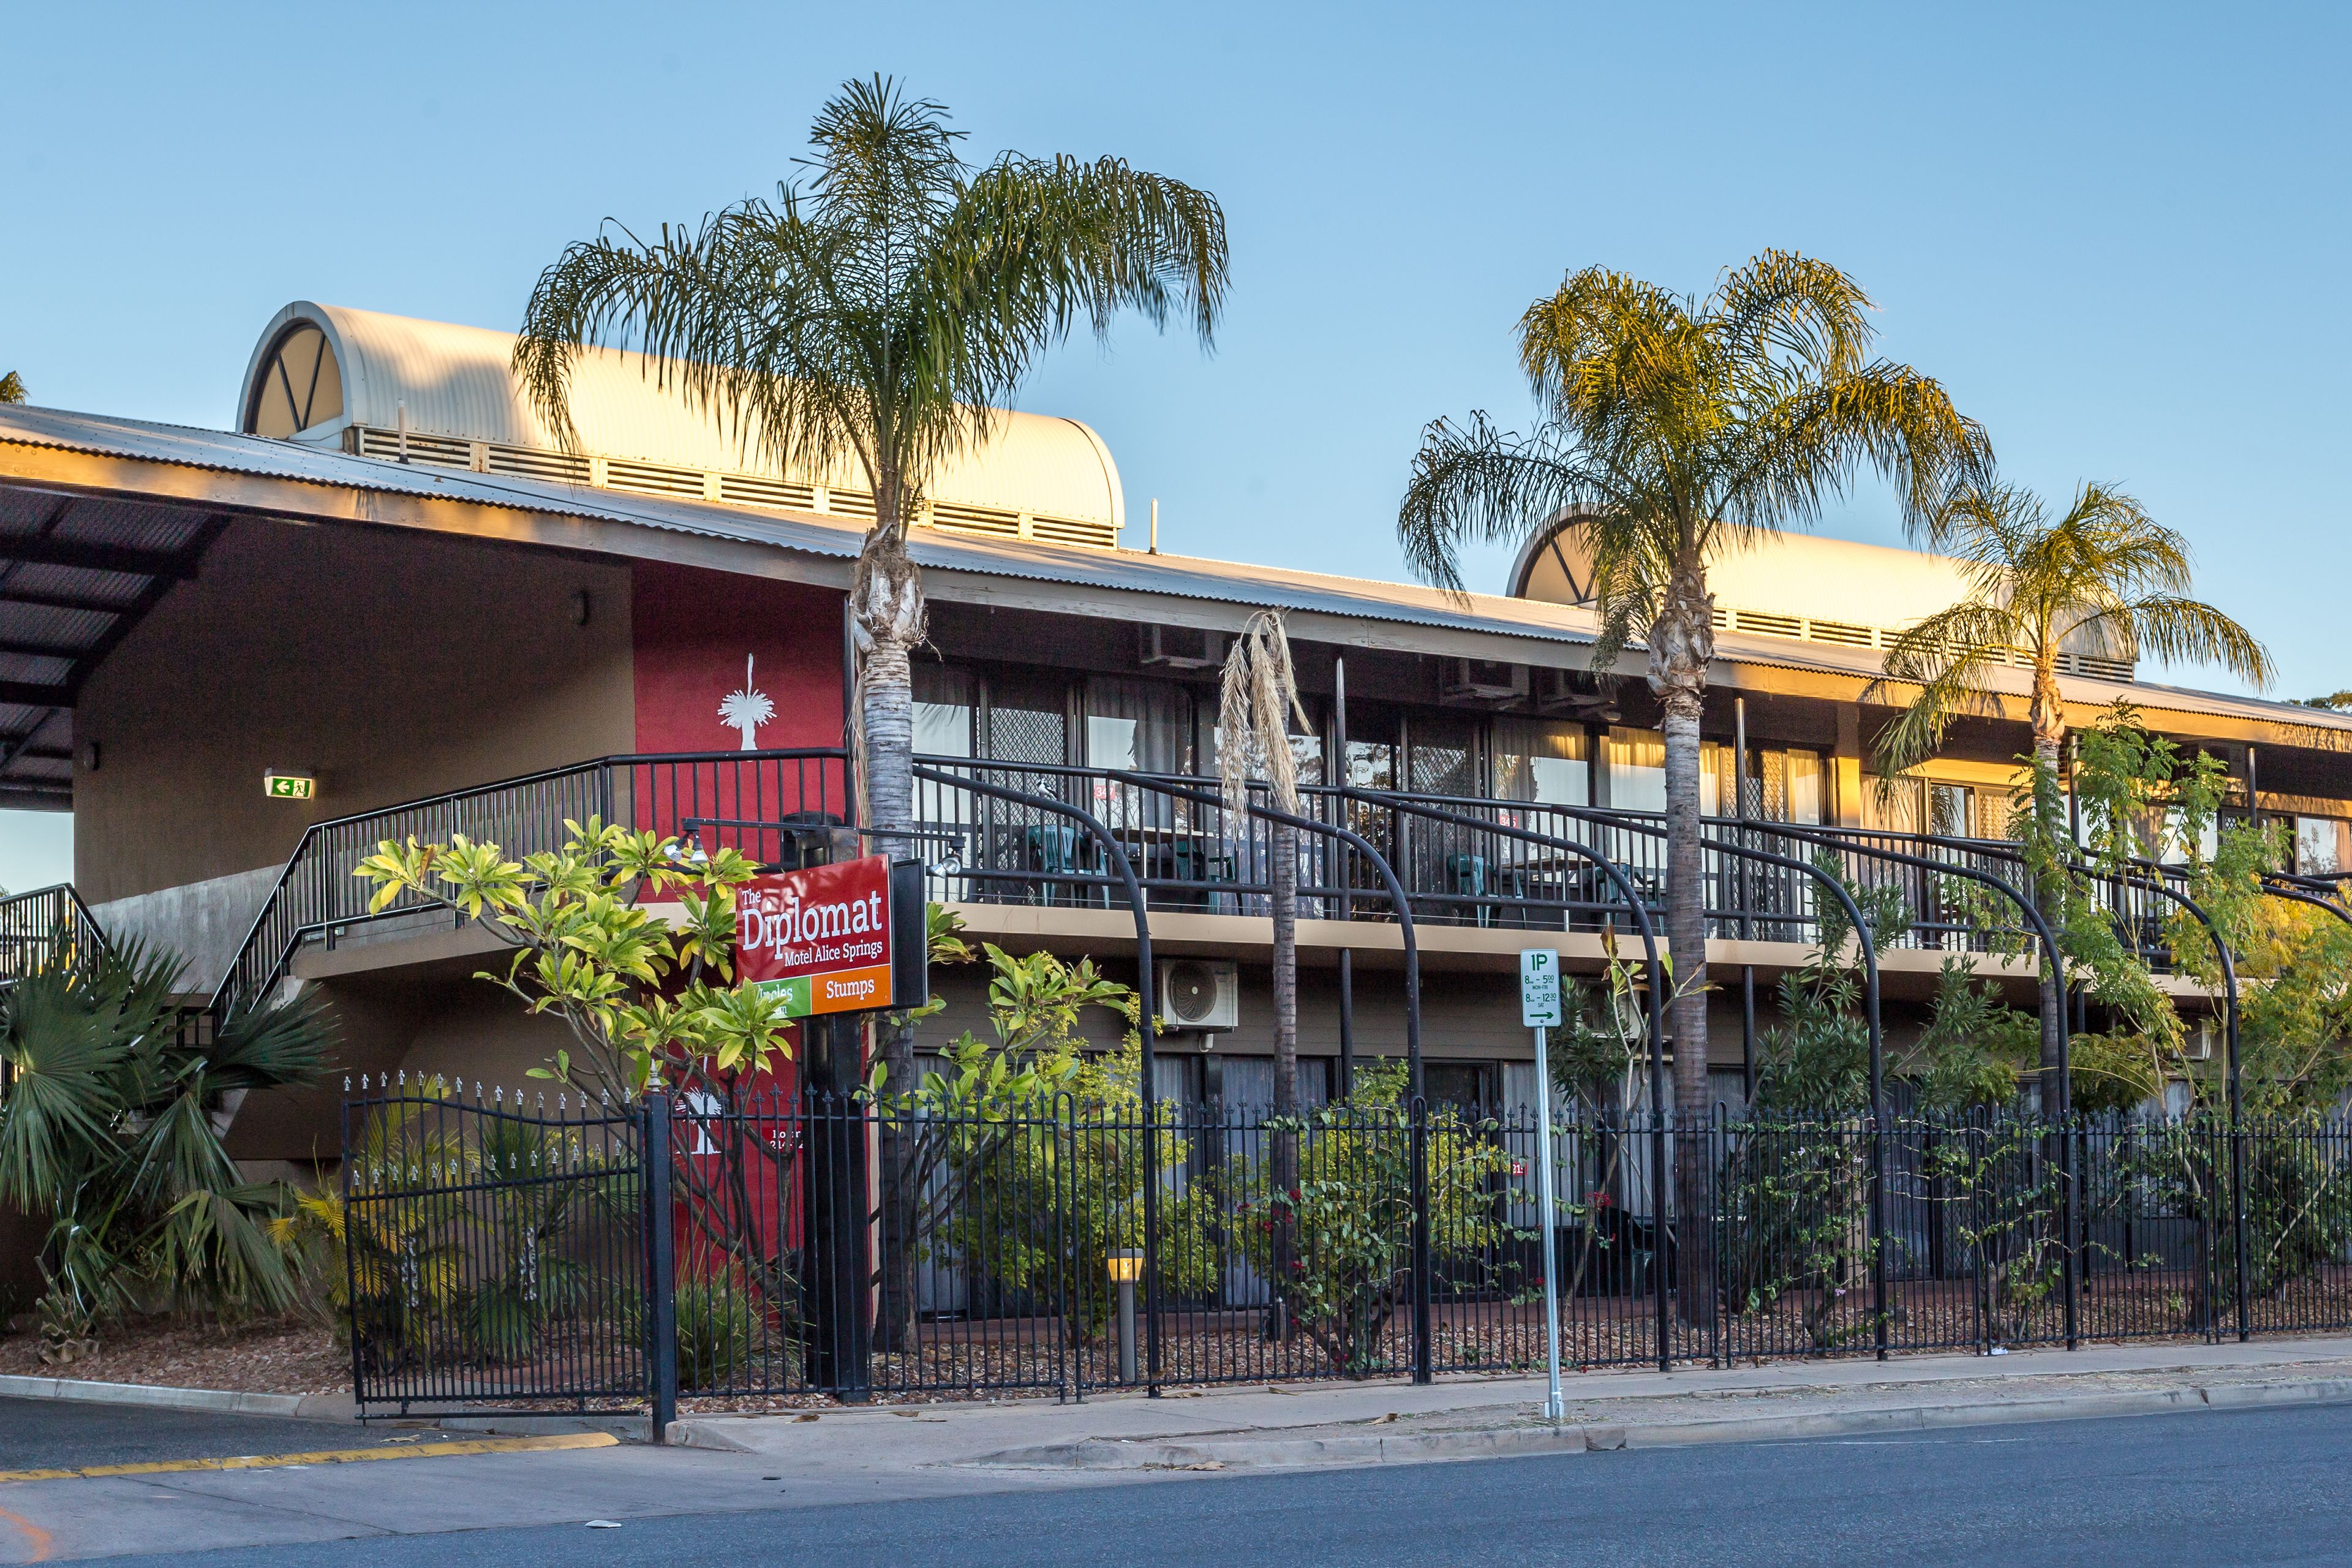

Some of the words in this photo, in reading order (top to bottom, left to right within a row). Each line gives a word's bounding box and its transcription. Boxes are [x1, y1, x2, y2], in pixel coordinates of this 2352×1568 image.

[742, 889, 761, 905] The
[742, 890, 883, 960] Diplomat
[784, 946, 813, 967] Motel
[814, 944, 840, 962] Alice
[843, 939, 883, 962] Springs
[1531, 953, 1548, 971] 1P
[826, 979, 875, 1000] Stumps
